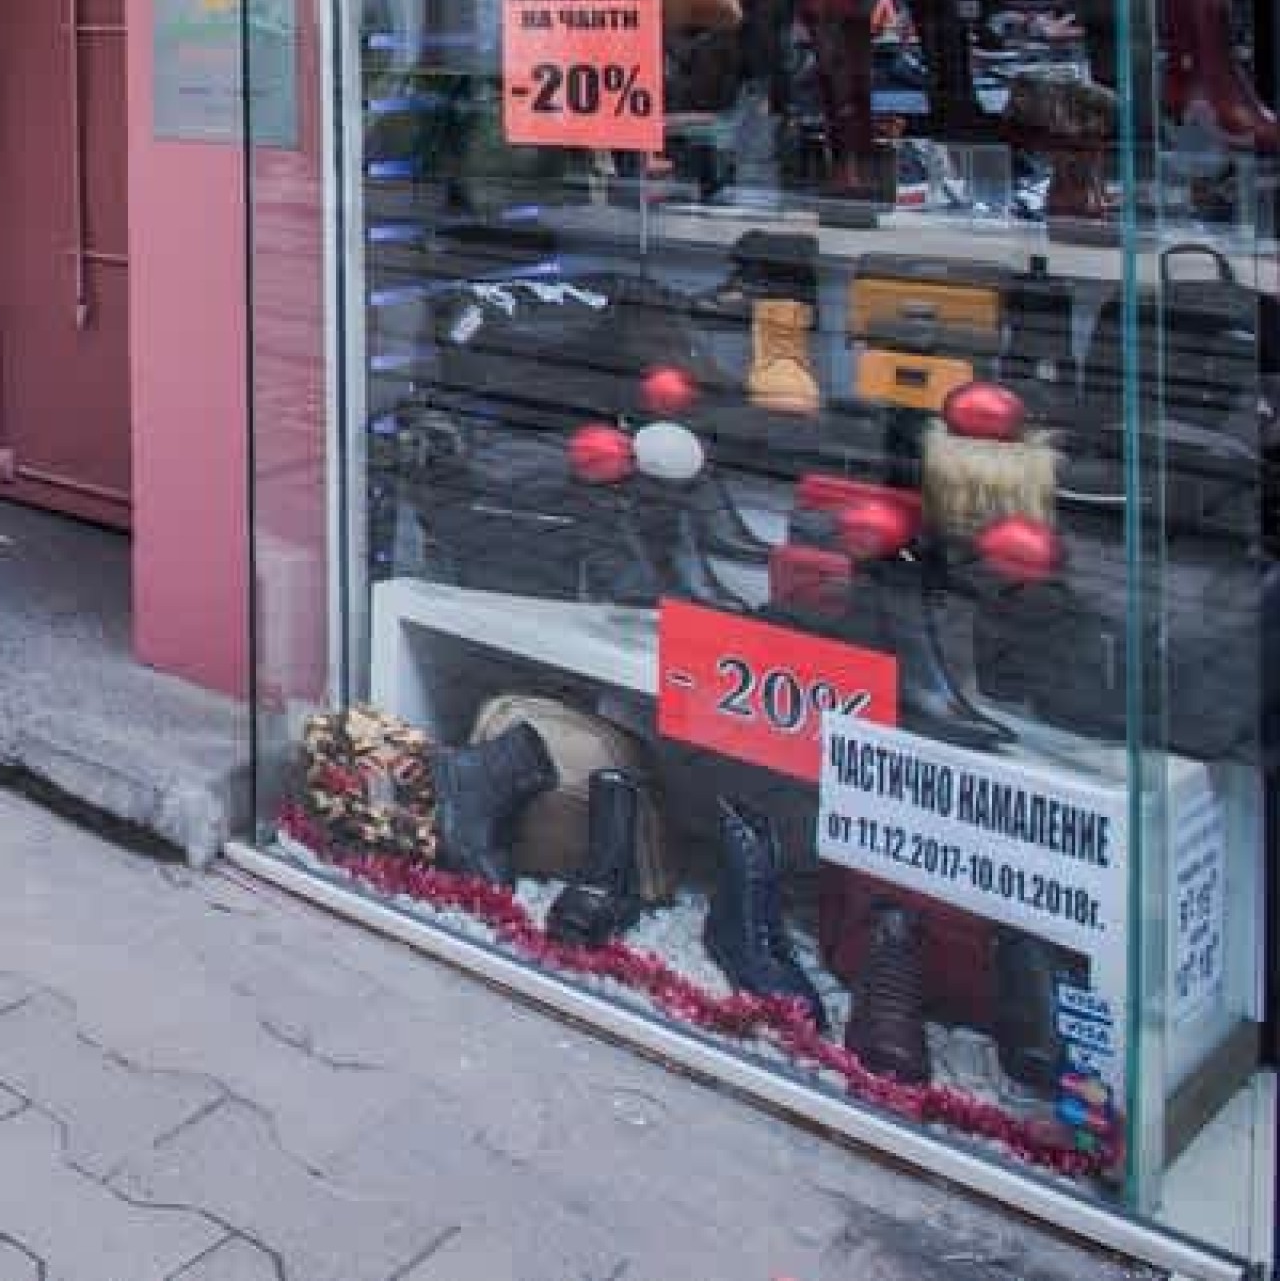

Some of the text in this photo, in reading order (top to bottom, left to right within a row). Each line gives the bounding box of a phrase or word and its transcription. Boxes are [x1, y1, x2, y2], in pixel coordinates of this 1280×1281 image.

[521, 8, 640, 31] НА ЧАНТИ
[510, 61, 652, 118] -20%
[831, 733, 1110, 868] ЧАСТИЧНО НАМАЛЕНИЕ
